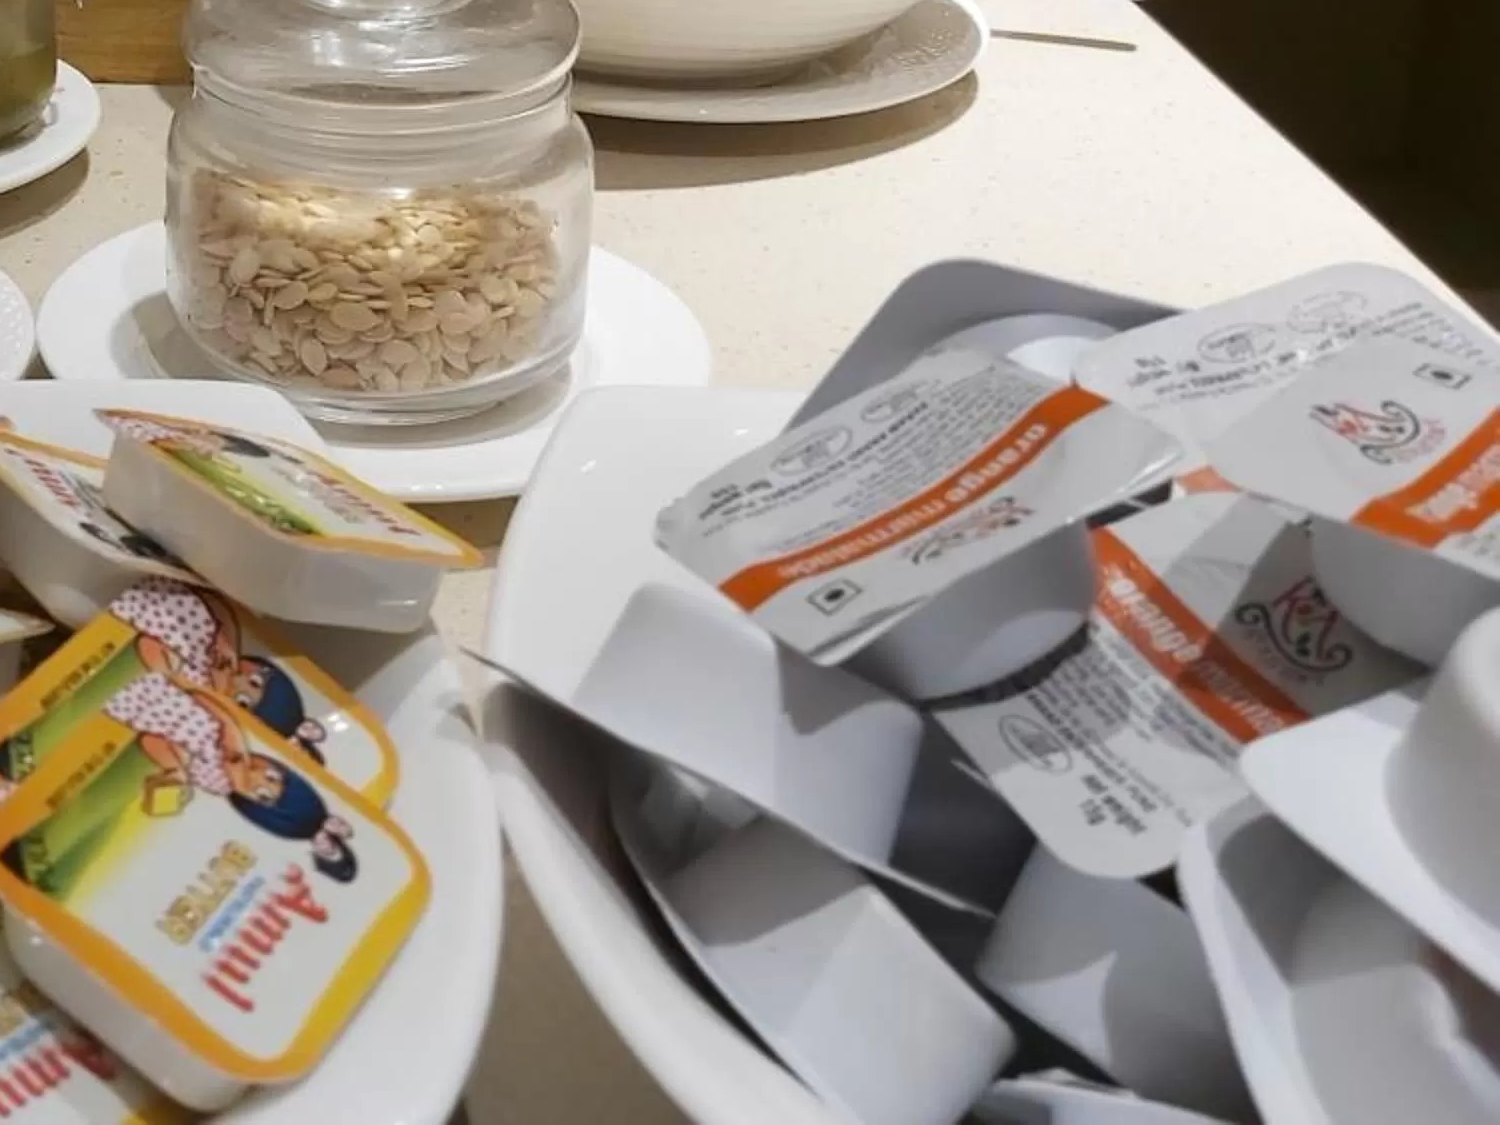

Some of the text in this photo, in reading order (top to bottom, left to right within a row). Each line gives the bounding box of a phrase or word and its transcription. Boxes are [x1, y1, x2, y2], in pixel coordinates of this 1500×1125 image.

[944, 423, 1048, 503] orange
[1109, 576, 1202, 664] orange
[154, 839, 259, 946] BUTTER
[201, 862, 329, 1013] Amul
